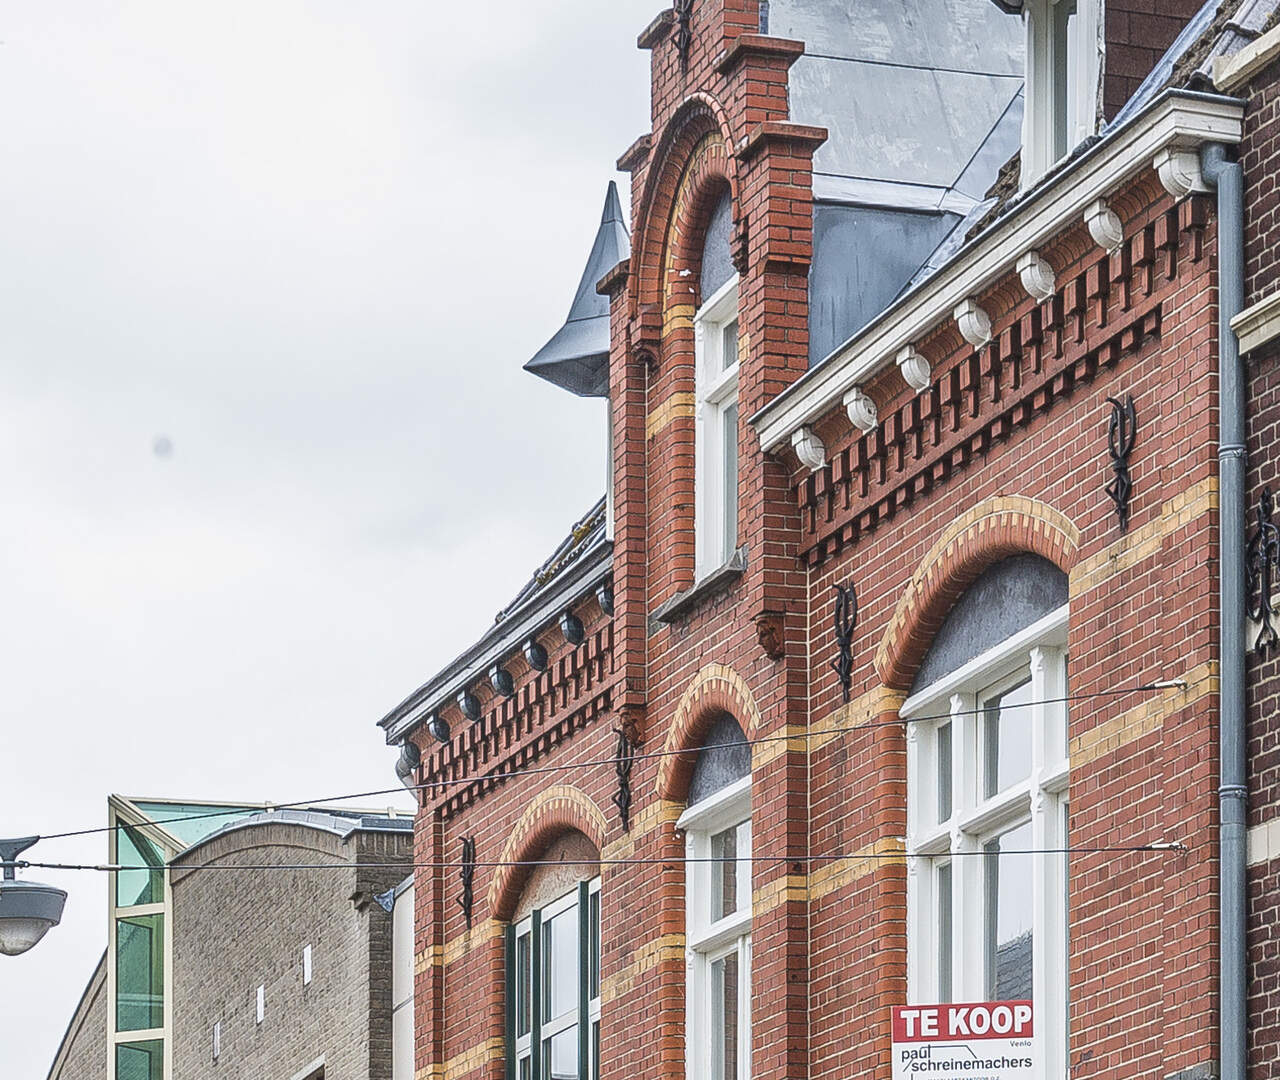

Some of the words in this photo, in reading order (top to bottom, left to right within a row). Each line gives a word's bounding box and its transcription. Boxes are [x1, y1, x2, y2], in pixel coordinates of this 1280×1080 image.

[900, 1009, 939, 1038] TE
[948, 1005, 1032, 1035] KOOP
[901, 1044, 931, 1063] paul
[911, 1056, 1033, 1072] schreinemachers
